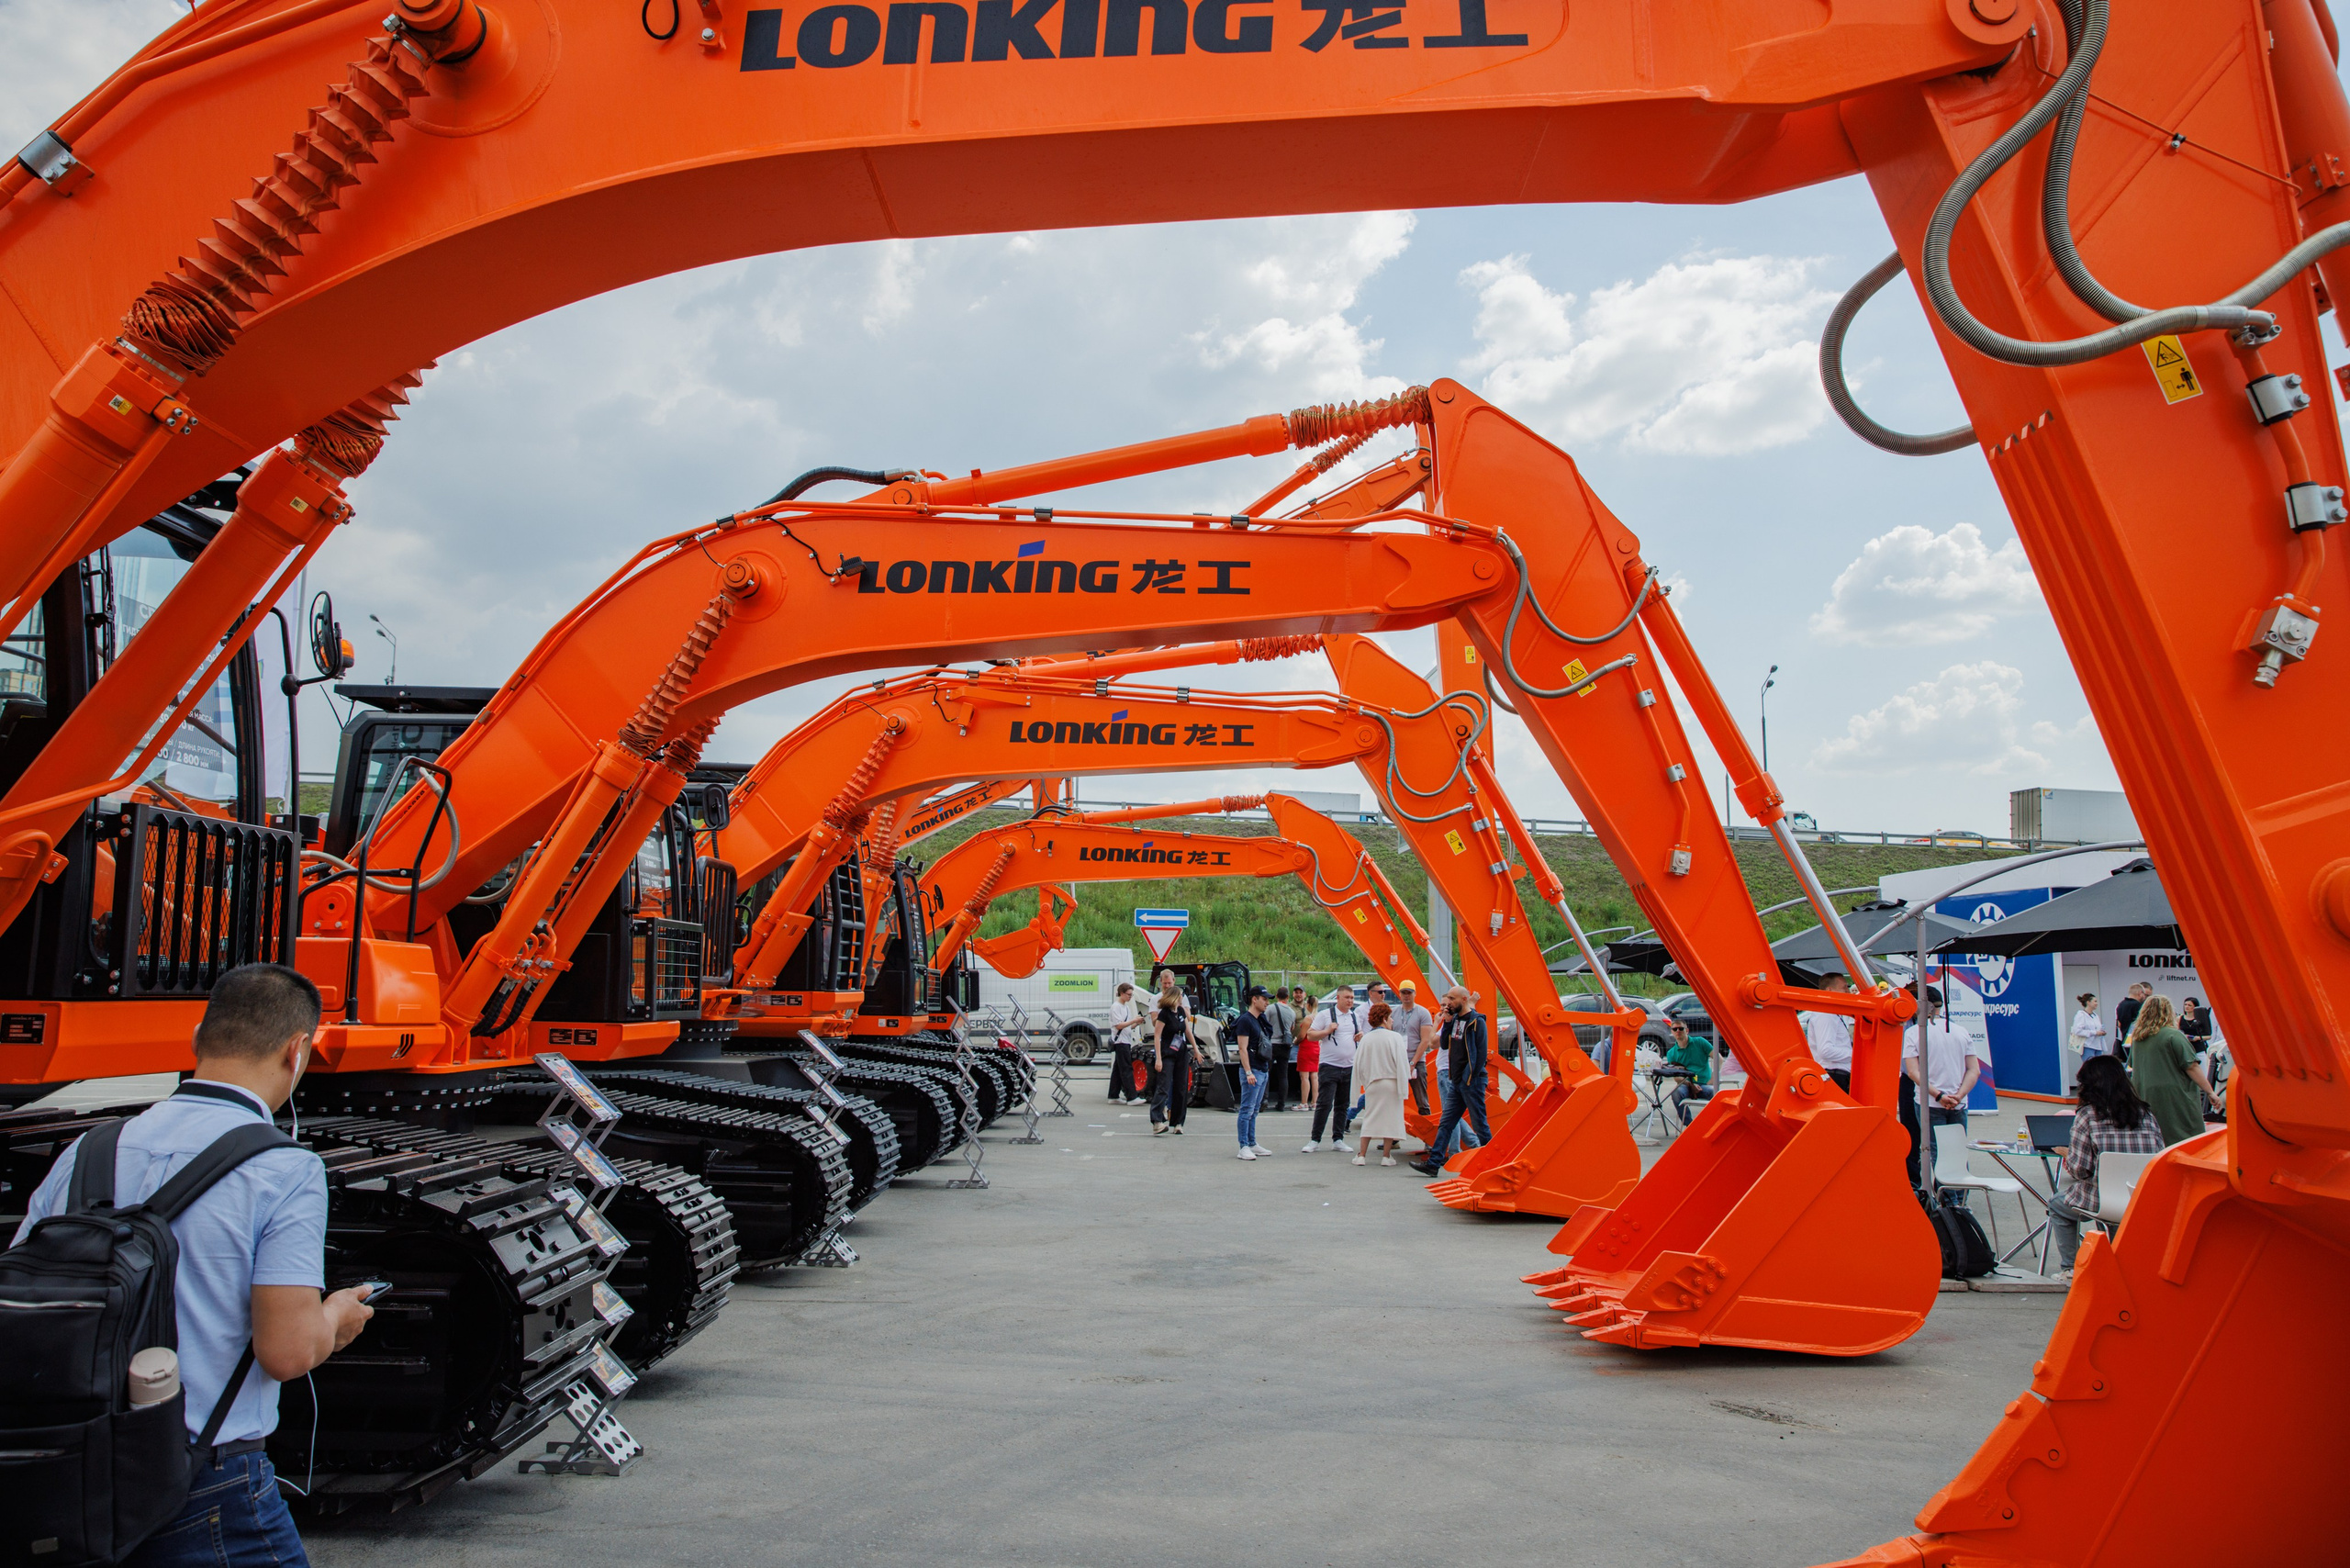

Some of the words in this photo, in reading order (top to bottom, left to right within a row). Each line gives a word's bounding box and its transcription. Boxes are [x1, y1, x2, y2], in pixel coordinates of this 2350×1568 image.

[740, 0, 1275, 72] LONKING
[857, 539, 1120, 594] LONKING
[1131, 559, 1251, 595] 龙工
[1010, 710, 1177, 746] LONKING
[1183, 723, 1255, 746] 龙工
[904, 803, 964, 838] LONKING
[964, 789, 993, 811] 龙工
[1080, 841, 1183, 864] LONKING
[1187, 850, 1231, 866] 龙工
[2128, 949, 2197, 969] LONKI
[1984, 1003, 2020, 1017] кресурс
